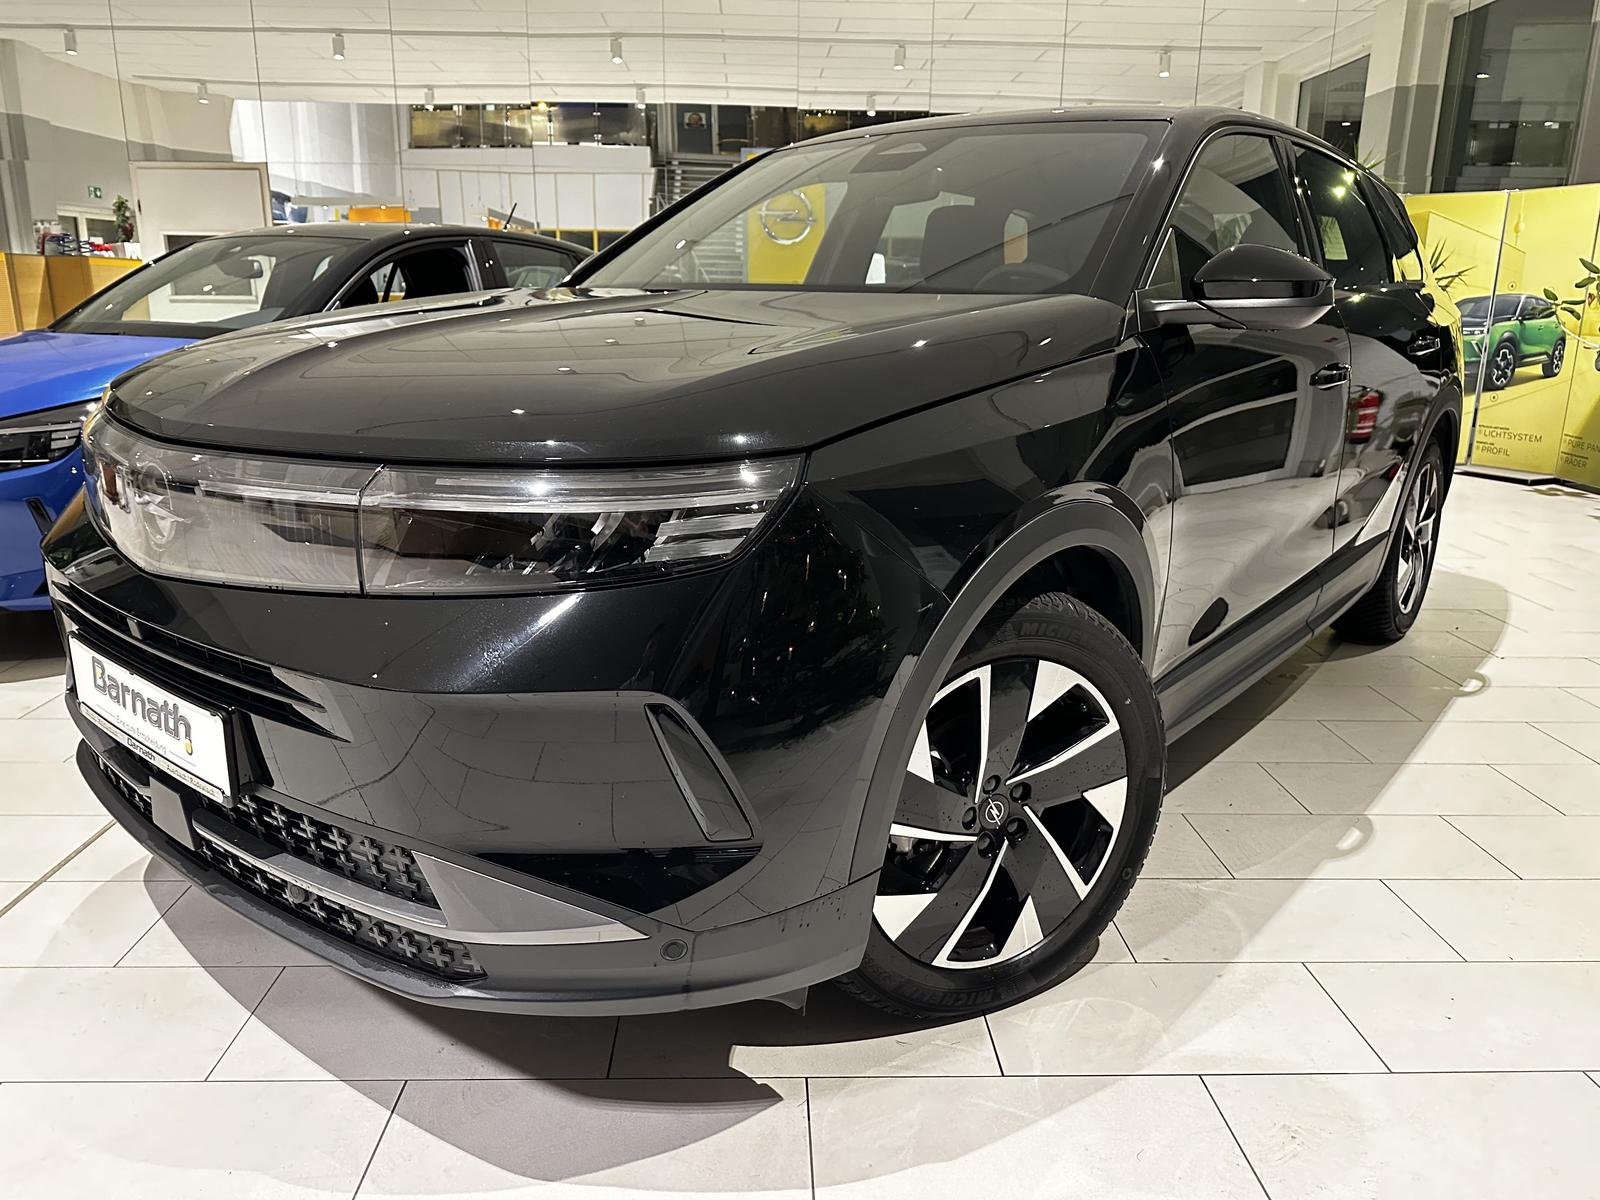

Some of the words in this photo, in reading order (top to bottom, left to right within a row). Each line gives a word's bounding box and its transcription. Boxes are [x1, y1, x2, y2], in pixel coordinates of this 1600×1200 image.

[1484, 430, 1543, 443] LICHTSYSTEM
[1481, 445, 1510, 457] PROFIL
[92, 655, 194, 756] Barnath
